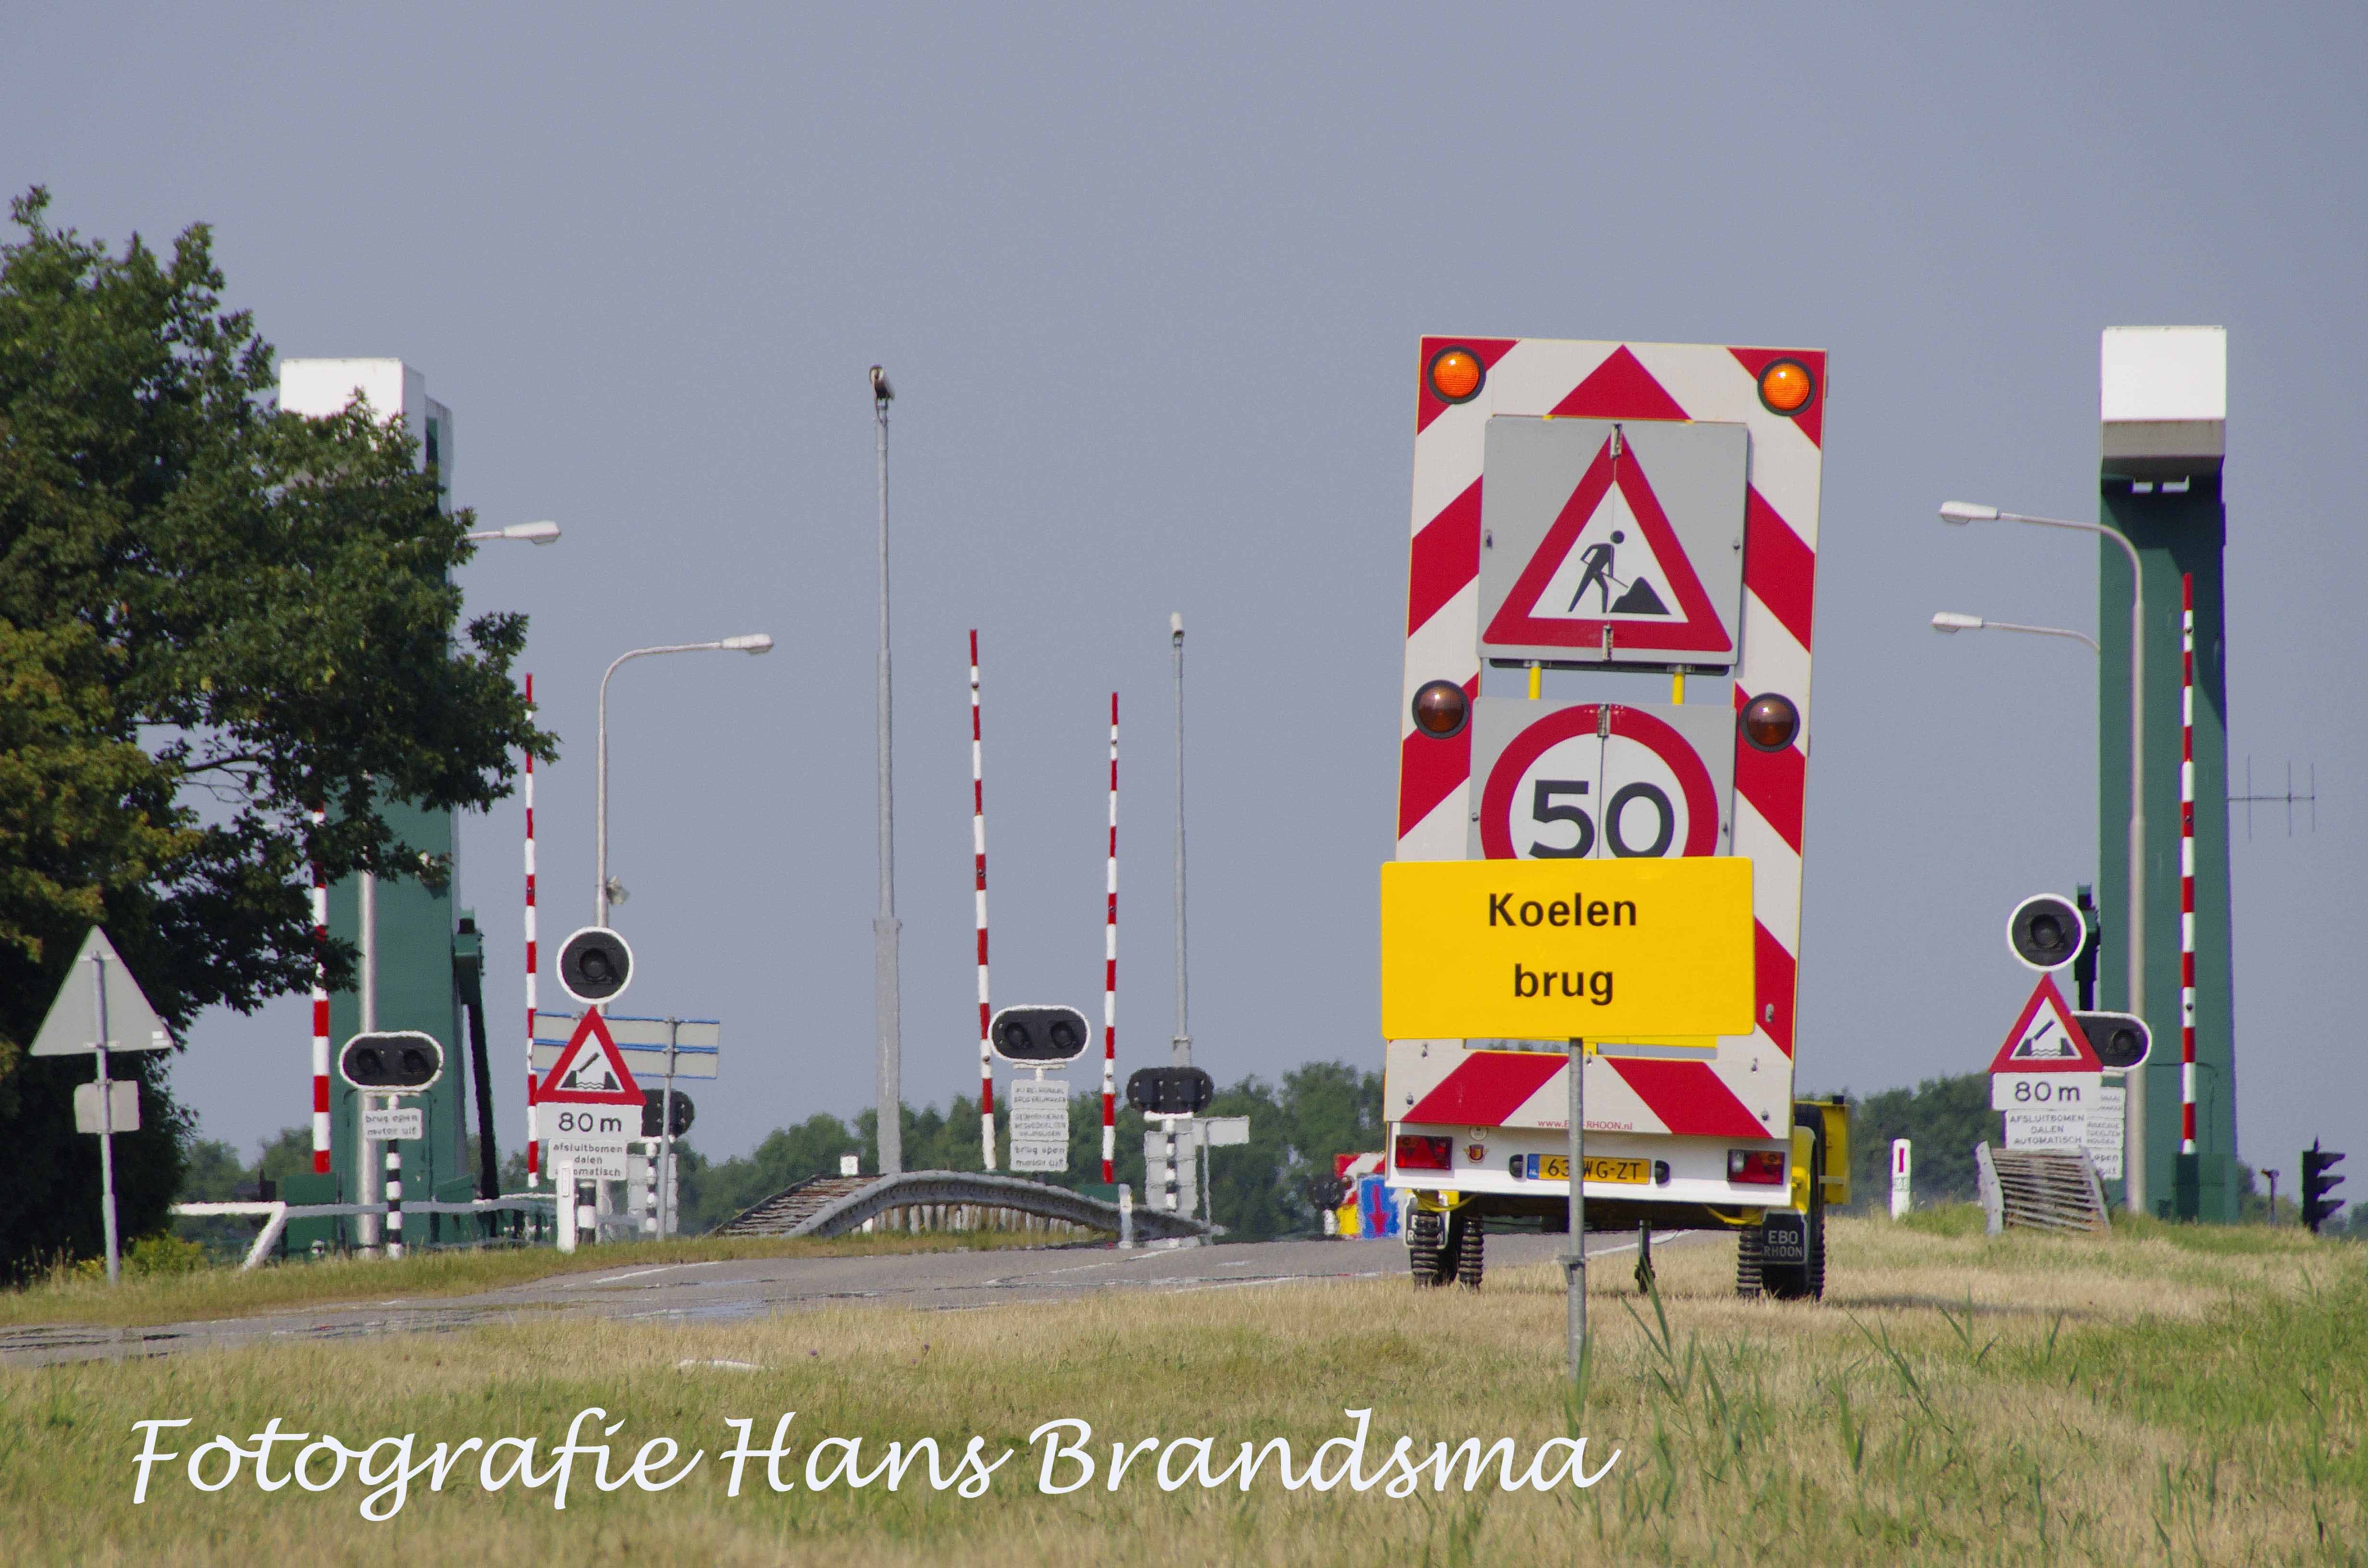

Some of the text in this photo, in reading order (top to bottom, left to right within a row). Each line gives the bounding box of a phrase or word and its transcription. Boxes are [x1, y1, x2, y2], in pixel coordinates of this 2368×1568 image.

[1529, 780, 1675, 859] 50
[1489, 892, 1637, 927] Koelen
[1514, 963, 1613, 1006] brug
[2015, 1081, 2081, 1102] 80 m
[558, 1112, 622, 1132] 80 m
[1538, 1119, 1632, 1130] www.E-RHOON.nl
[2031, 1125, 2064, 1134] DALEN
[553, 1141, 623, 1153] afsluitbomen
[574, 1155, 603, 1164] dalen
[555, 1167, 621, 1176] omatisch
[1768, 1230, 1799, 1245] EBO
